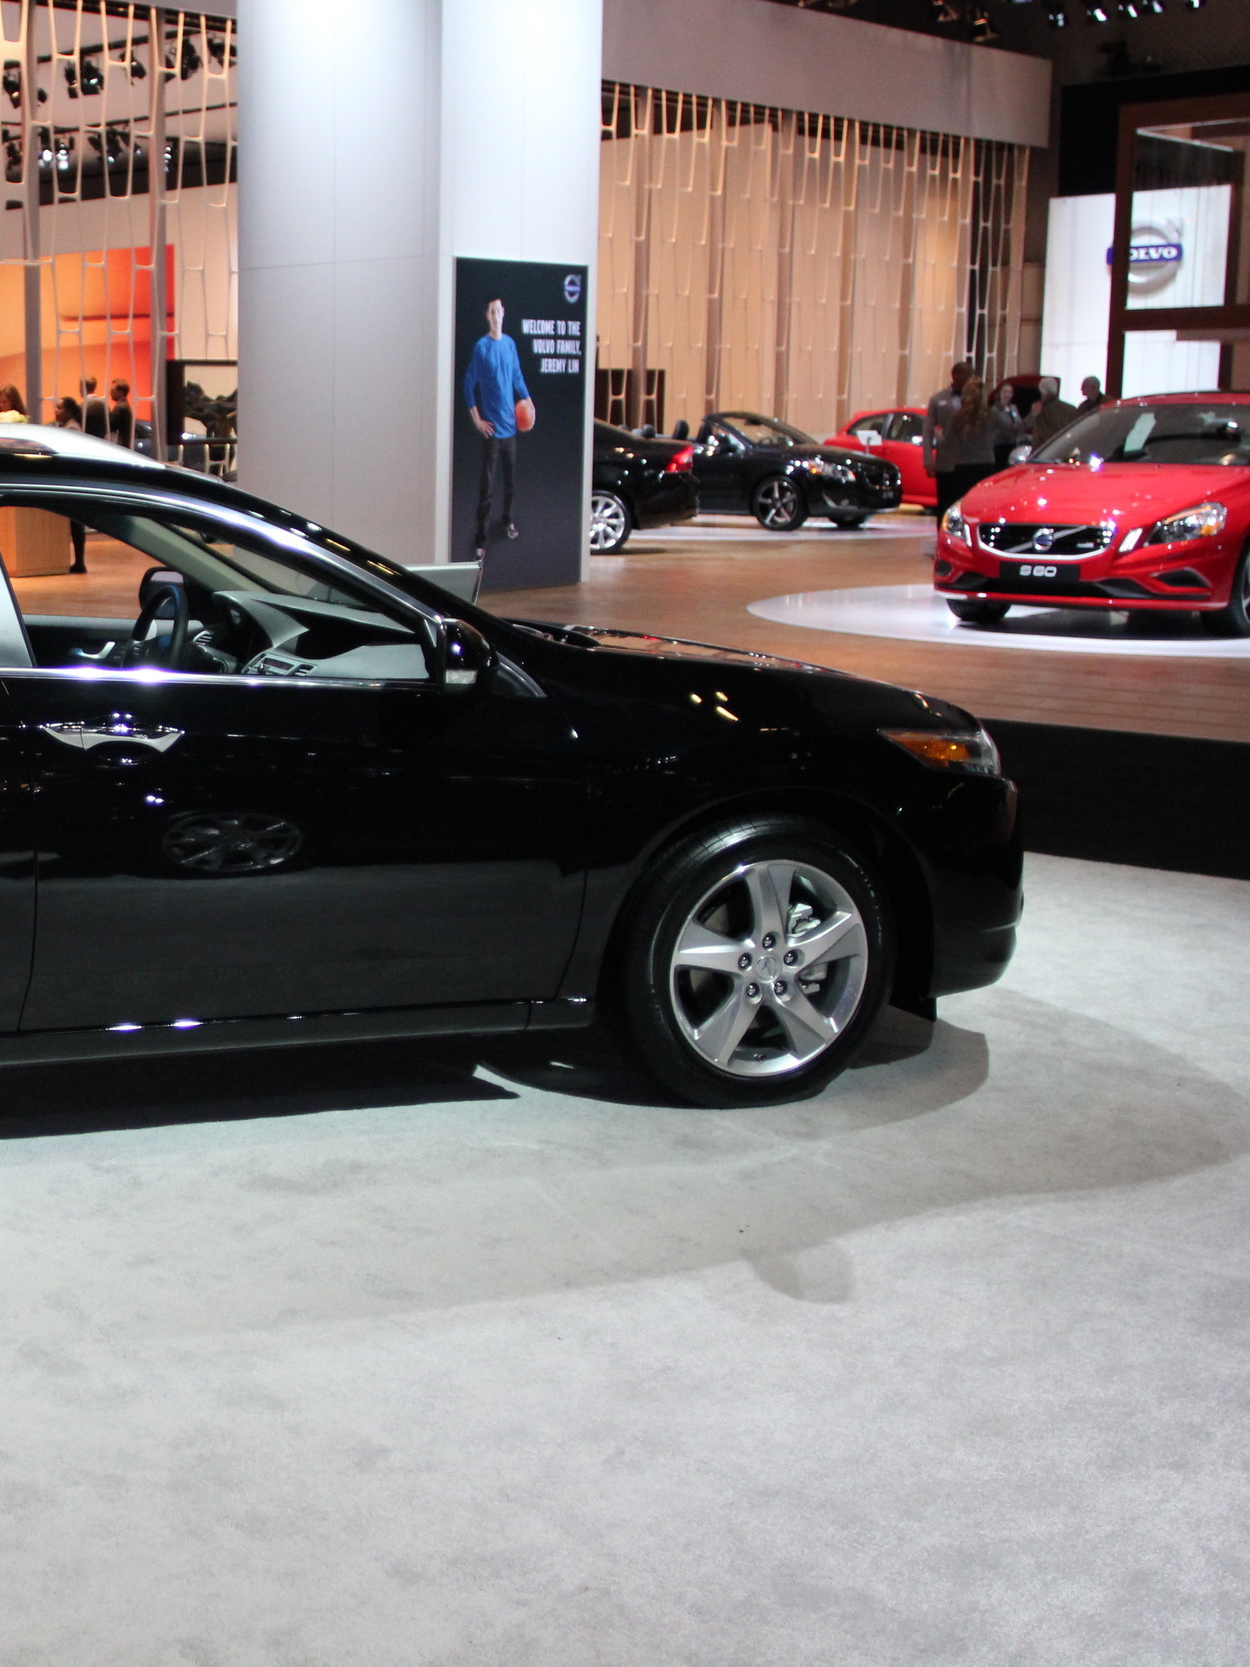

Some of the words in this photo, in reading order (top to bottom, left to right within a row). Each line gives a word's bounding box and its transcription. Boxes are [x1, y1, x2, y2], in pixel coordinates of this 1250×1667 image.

[1129, 246, 1178, 261] OLVO
[522, 319, 555, 335] WELCOME
[557, 320, 566, 336] TO
[568, 321, 581, 336] THE
[533, 339, 555, 354] VOLVO
[541, 358, 566, 373] JEREMY
[568, 359, 580, 373] LIN
